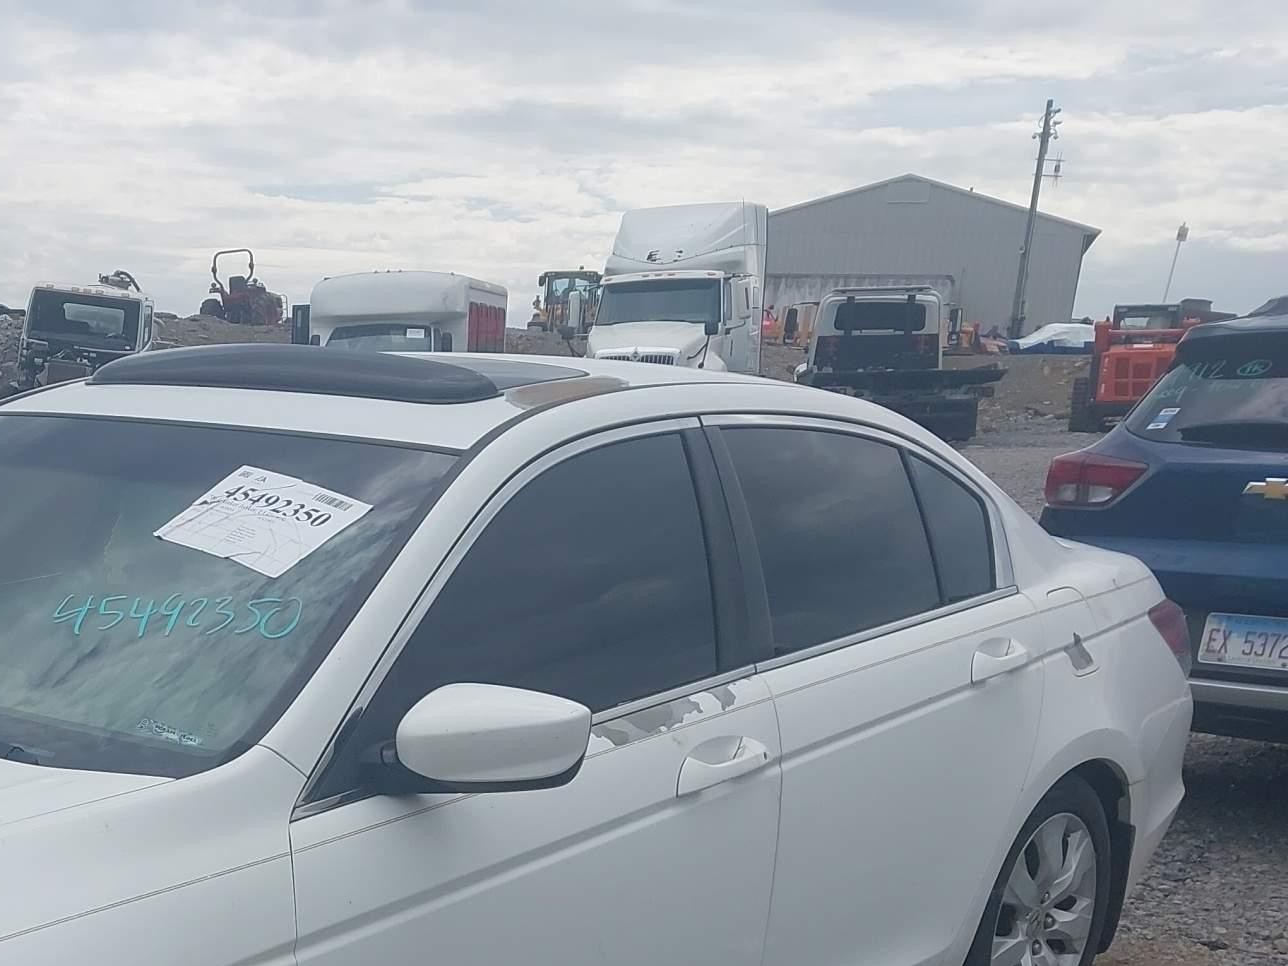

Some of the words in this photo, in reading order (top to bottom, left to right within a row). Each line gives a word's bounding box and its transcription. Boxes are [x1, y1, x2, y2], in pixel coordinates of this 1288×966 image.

[224, 485, 332, 527] 45492350
[53, 593, 302, 638] 45492350
[1205, 628, 1233, 654] EX
